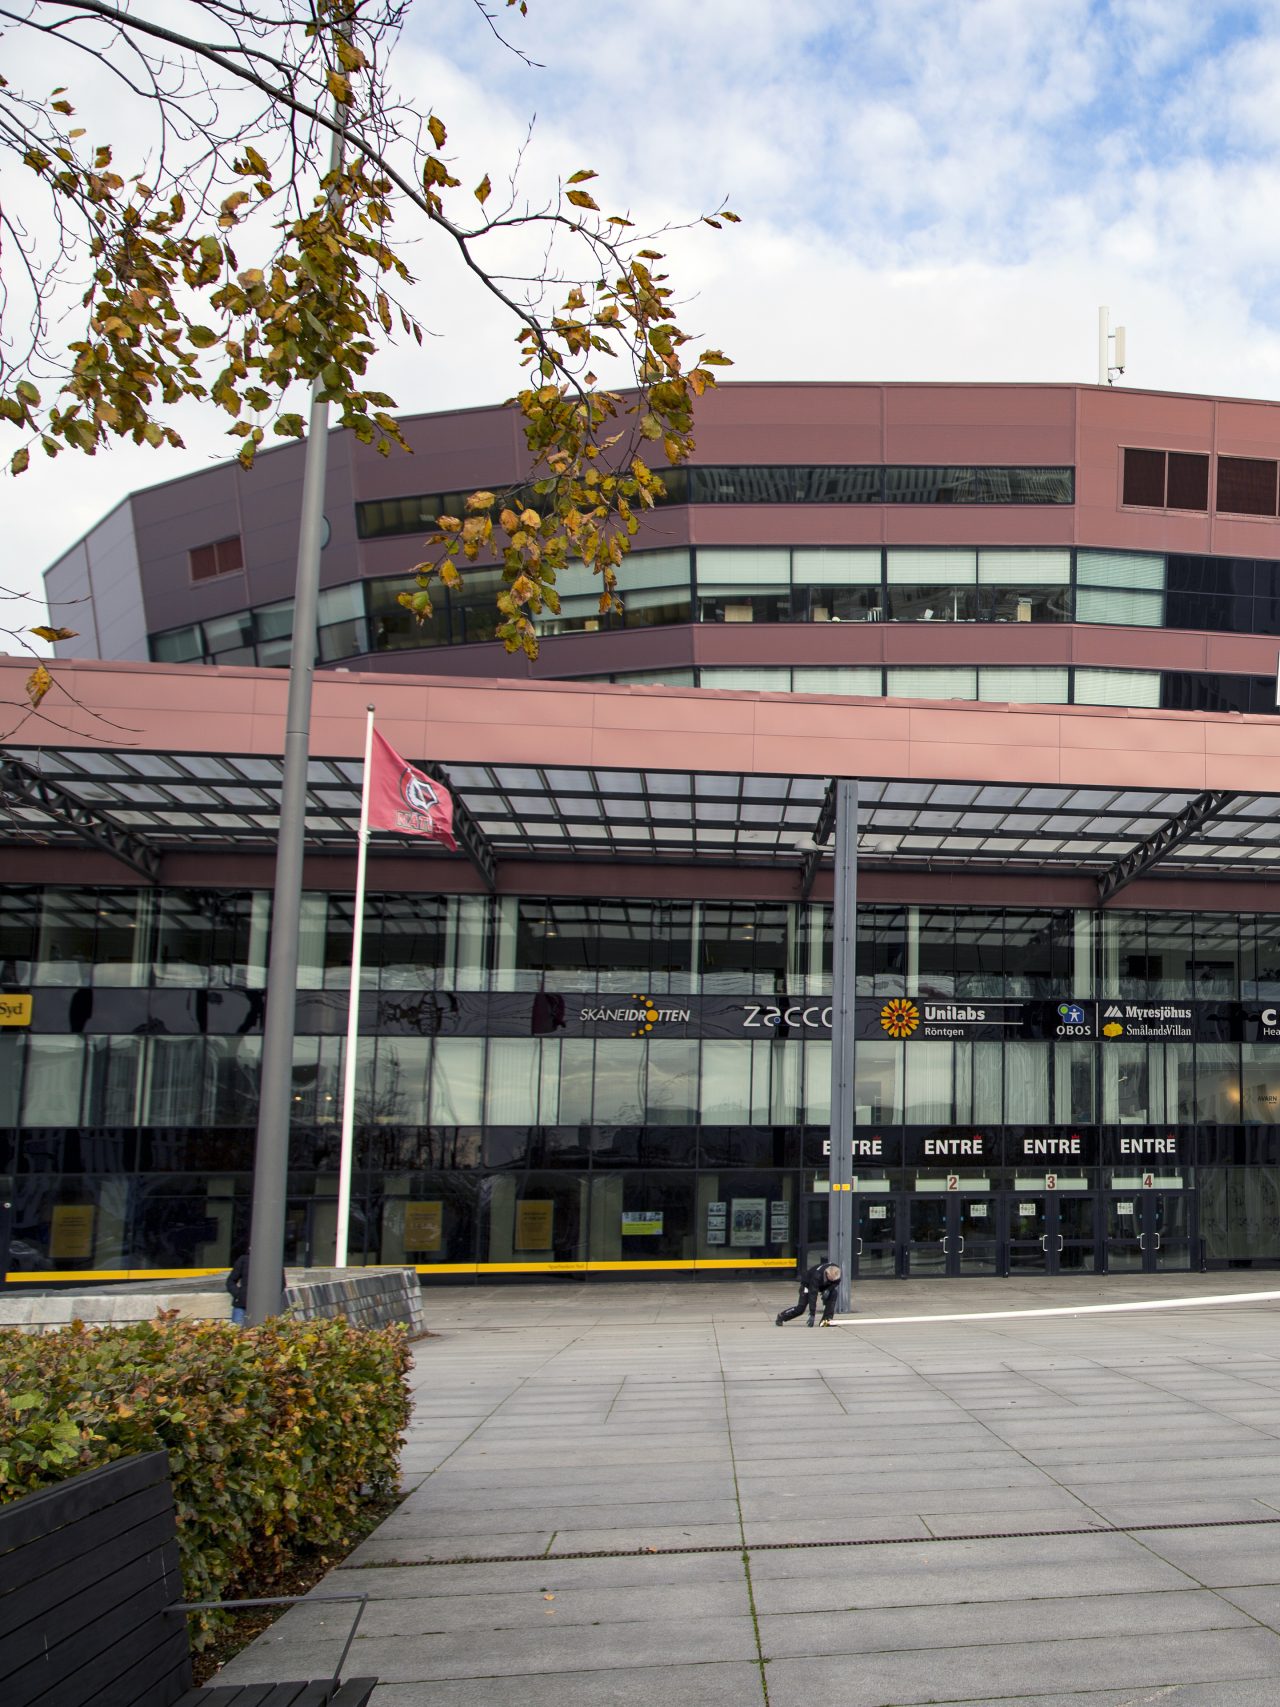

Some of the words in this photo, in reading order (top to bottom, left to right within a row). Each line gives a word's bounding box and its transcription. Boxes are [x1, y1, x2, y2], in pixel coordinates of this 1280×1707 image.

[0, 1001, 24, 1018] Syd
[924, 1005, 986, 1020] Unilabs
[1125, 1005, 1192, 1020] Myresjöhus
[924, 1027, 964, 1038] Röntgen
[1056, 1025, 1092, 1036] OBOS
[1126, 1023, 1192, 1036] SmålandsVillan
[948, 1176, 958, 1190] 2
[1047, 1175, 1056, 1189] 3
[1143, 1175, 1153, 1188] 4
